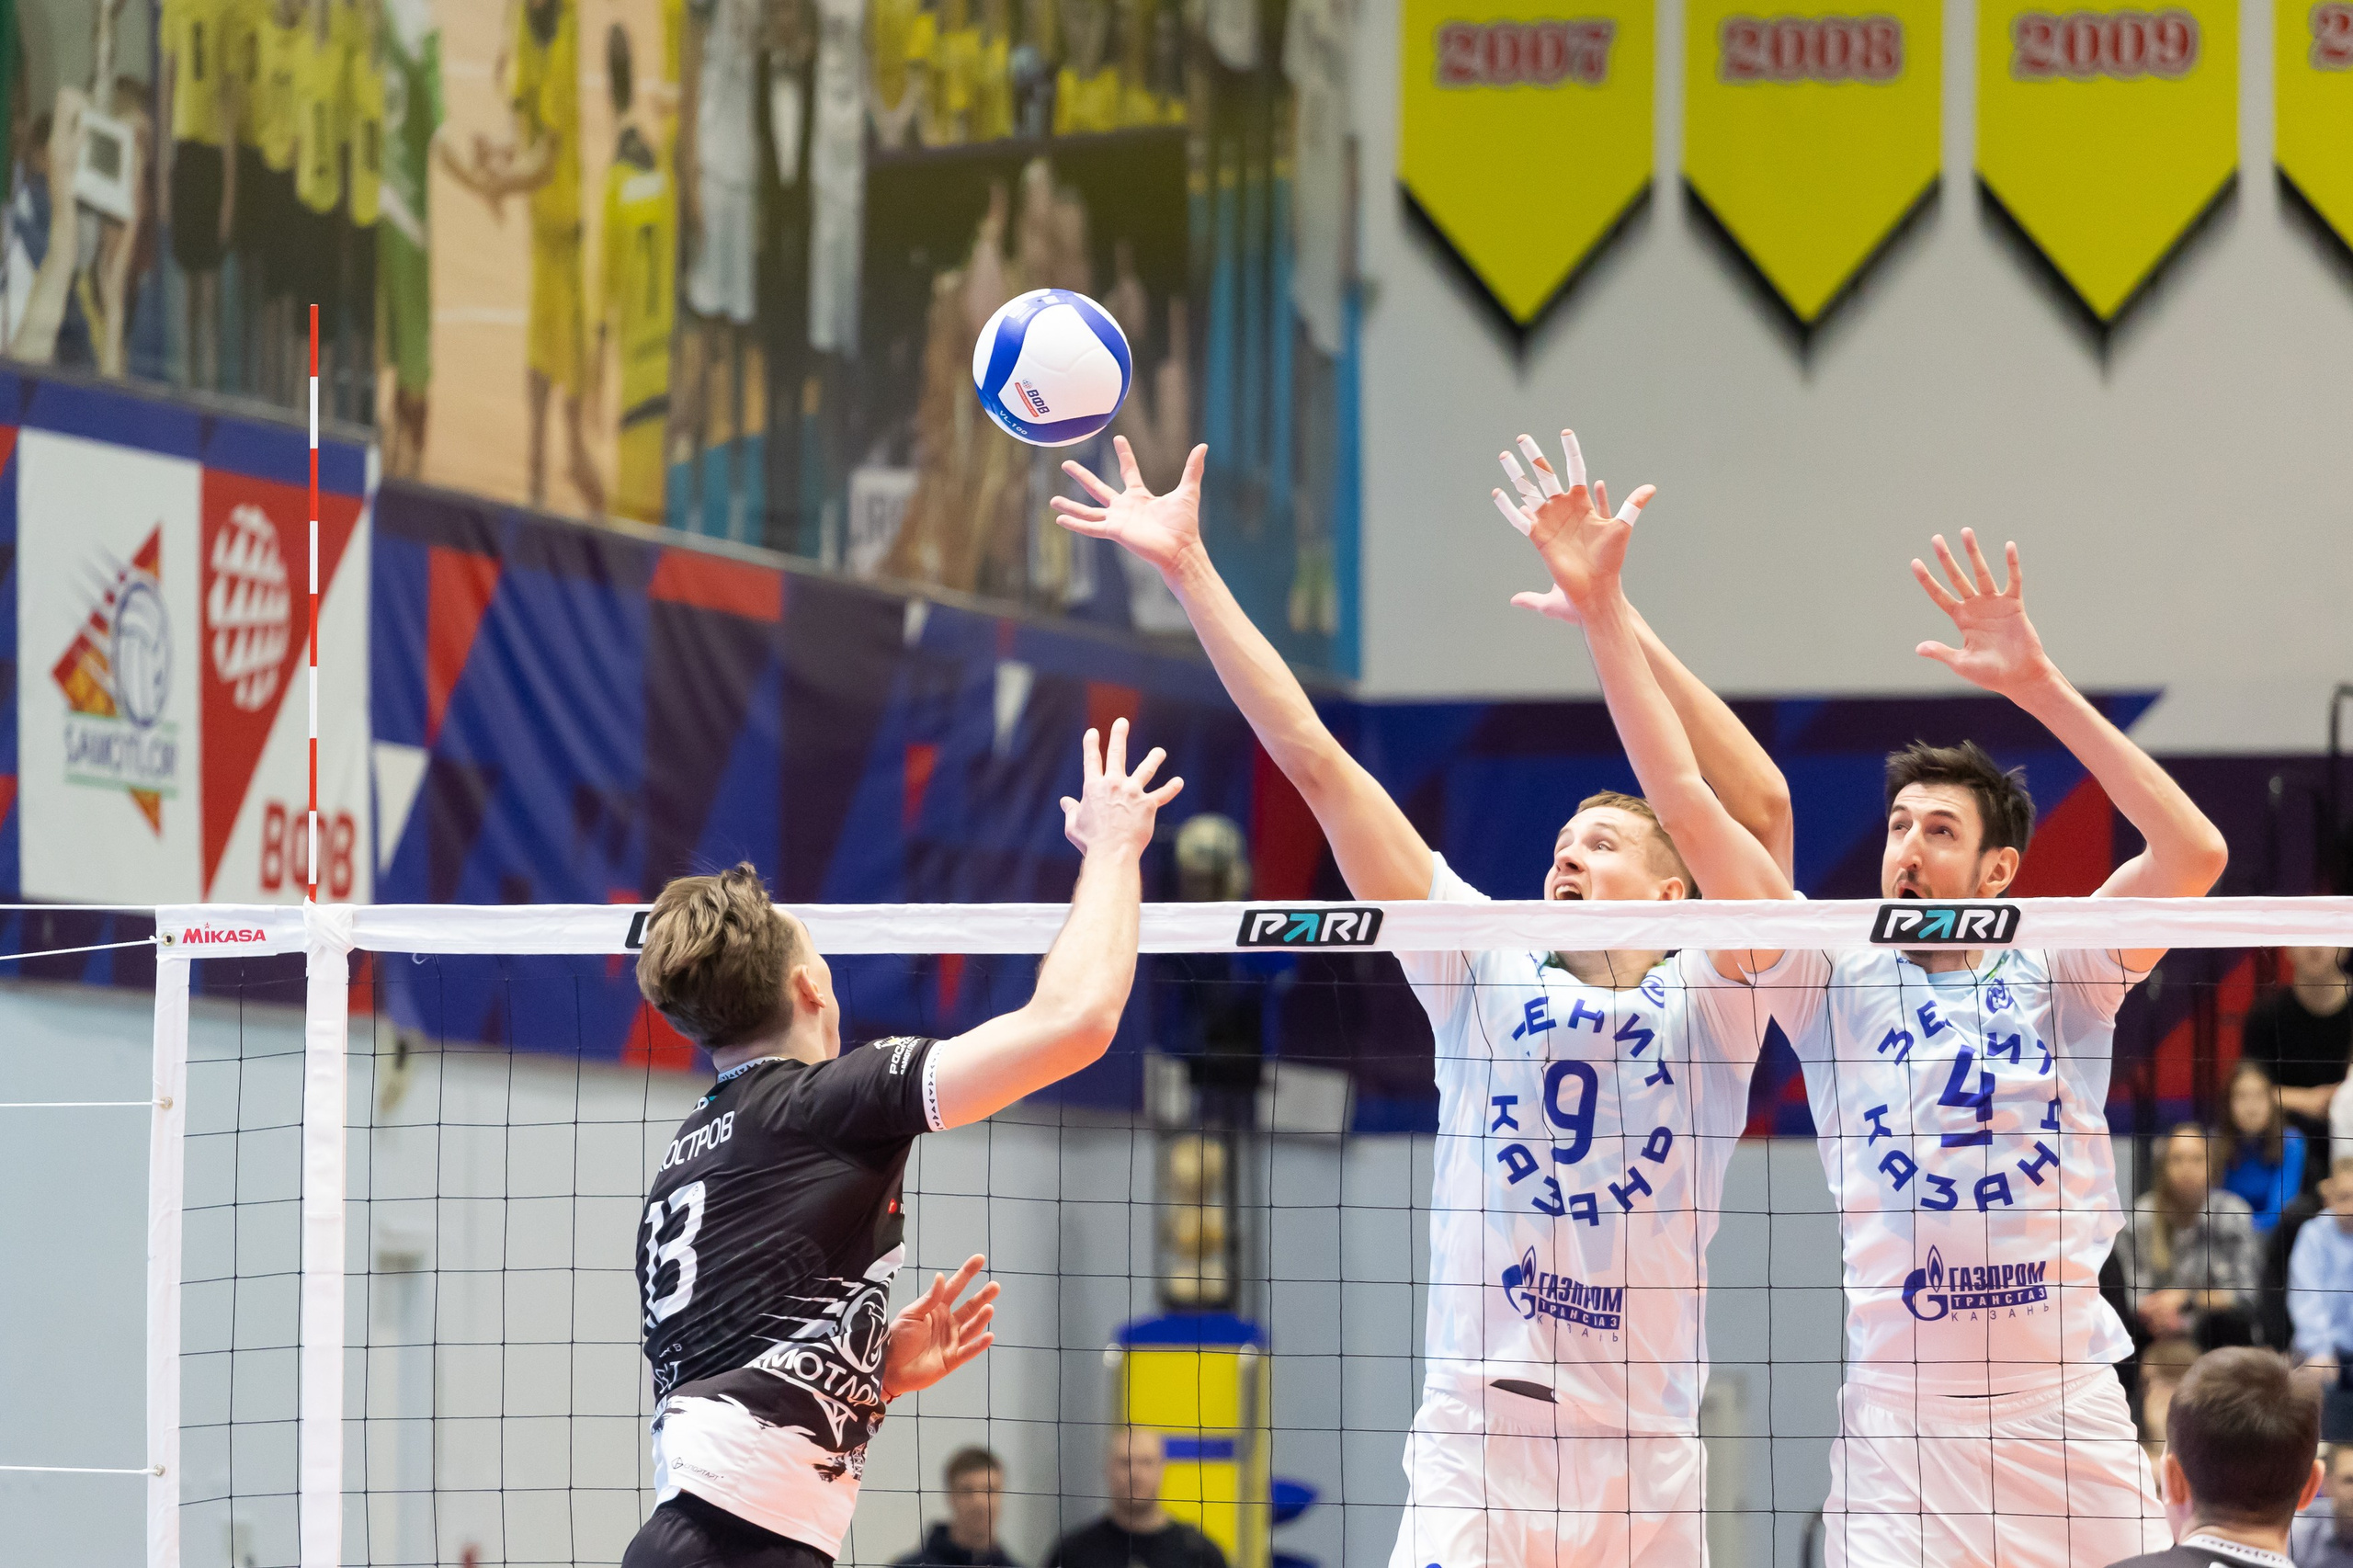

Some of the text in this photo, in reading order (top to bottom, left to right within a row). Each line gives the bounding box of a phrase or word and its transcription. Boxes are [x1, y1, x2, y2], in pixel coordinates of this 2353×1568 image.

[1436, 17, 1615, 88] 2007
[1718, 14, 1904, 86] 2008
[2010, 9, 2200, 81] 2009
[1026, 389, 1051, 415] ВФВ
[1248, 912, 1372, 943] PARI
[1882, 908, 2009, 939] PARI
[1543, 1060, 1598, 1165] 9
[1937, 1044, 1995, 1148] 4
[659, 1110, 735, 1172] ОСТРОВ
[644, 1180, 707, 1330] 13
[1949, 1260, 2046, 1292] ГАЗПРОМ
[1951, 1302, 2050, 1323] КАЗАНЬ
[1953, 1287, 2047, 1308] ТРАНСГАЗ
